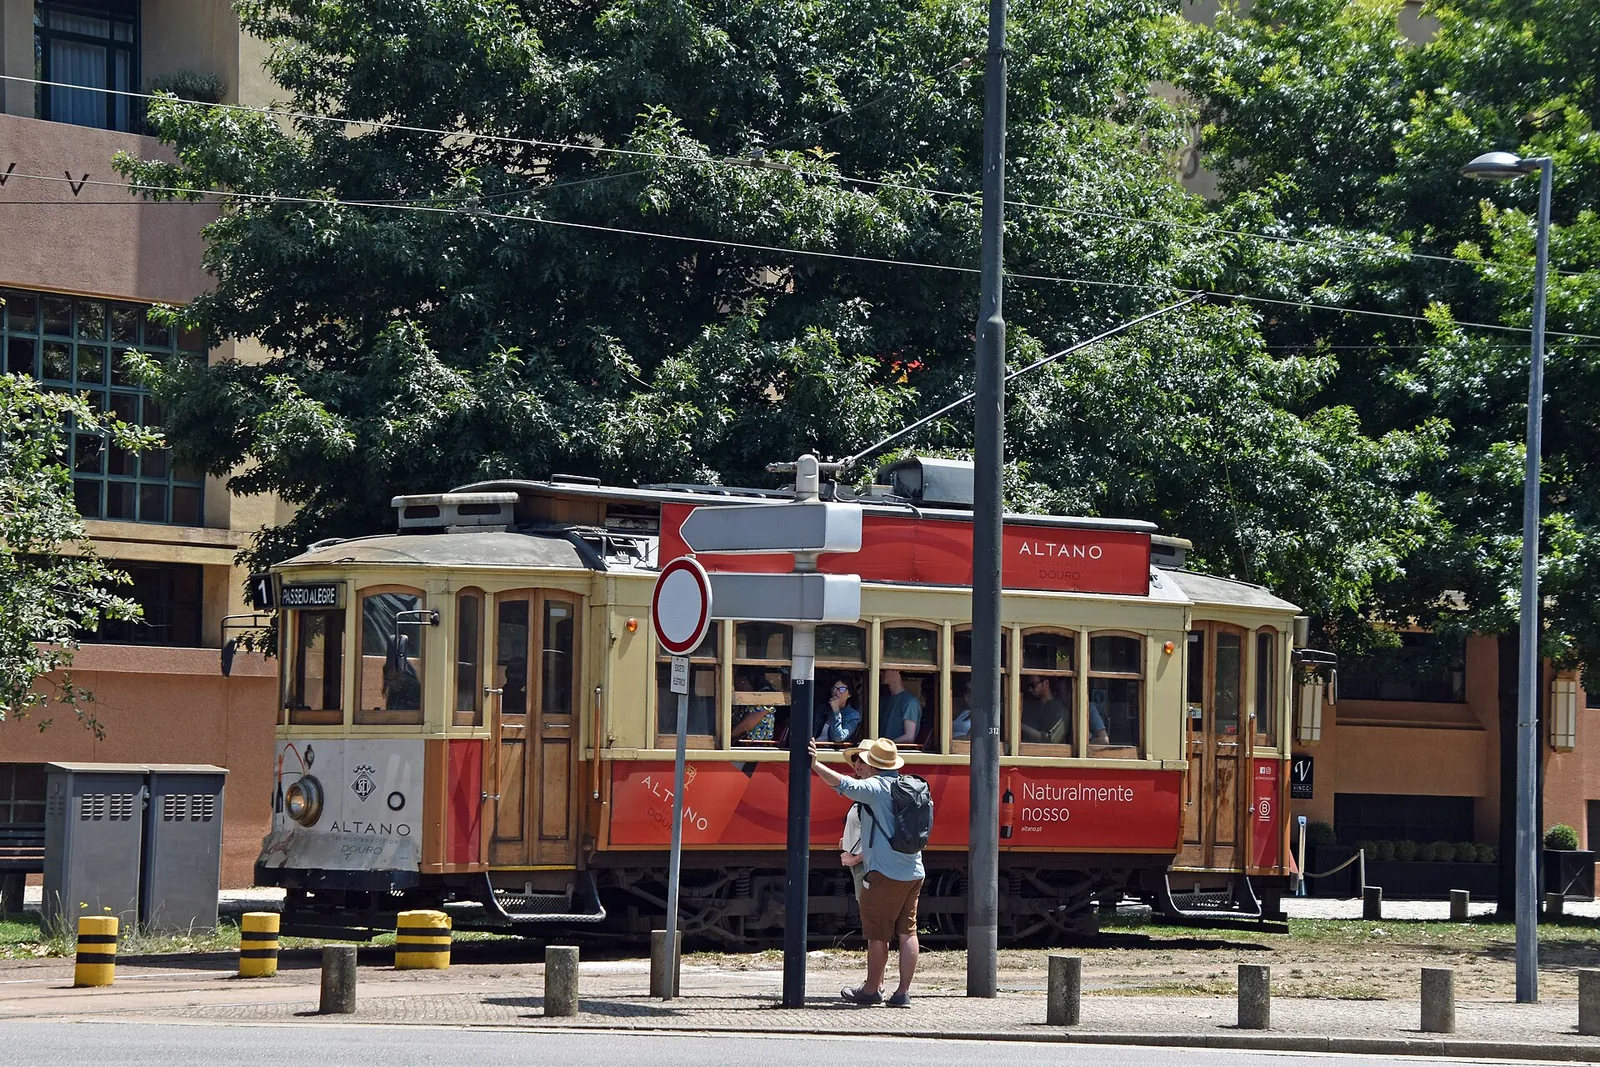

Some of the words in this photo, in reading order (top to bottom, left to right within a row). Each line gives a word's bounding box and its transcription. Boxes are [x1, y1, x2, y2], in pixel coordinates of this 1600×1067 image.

[1019, 541, 1103, 560] ALTANO
[1039, 569, 1081, 581] DOURO
[257, 579, 268, 605] 1
[281, 588, 309, 605] PASSEIO
[308, 587, 336, 604] ALEGRE
[988, 727, 1000, 735] 312
[1294, 760, 1311, 782] V
[1022, 782, 1134, 802] Naturalmente
[641, 775, 709, 831] ALTNO
[1021, 807, 1070, 822] nosso
[330, 821, 411, 836] ALTANO
[341, 844, 383, 855] DOURO
